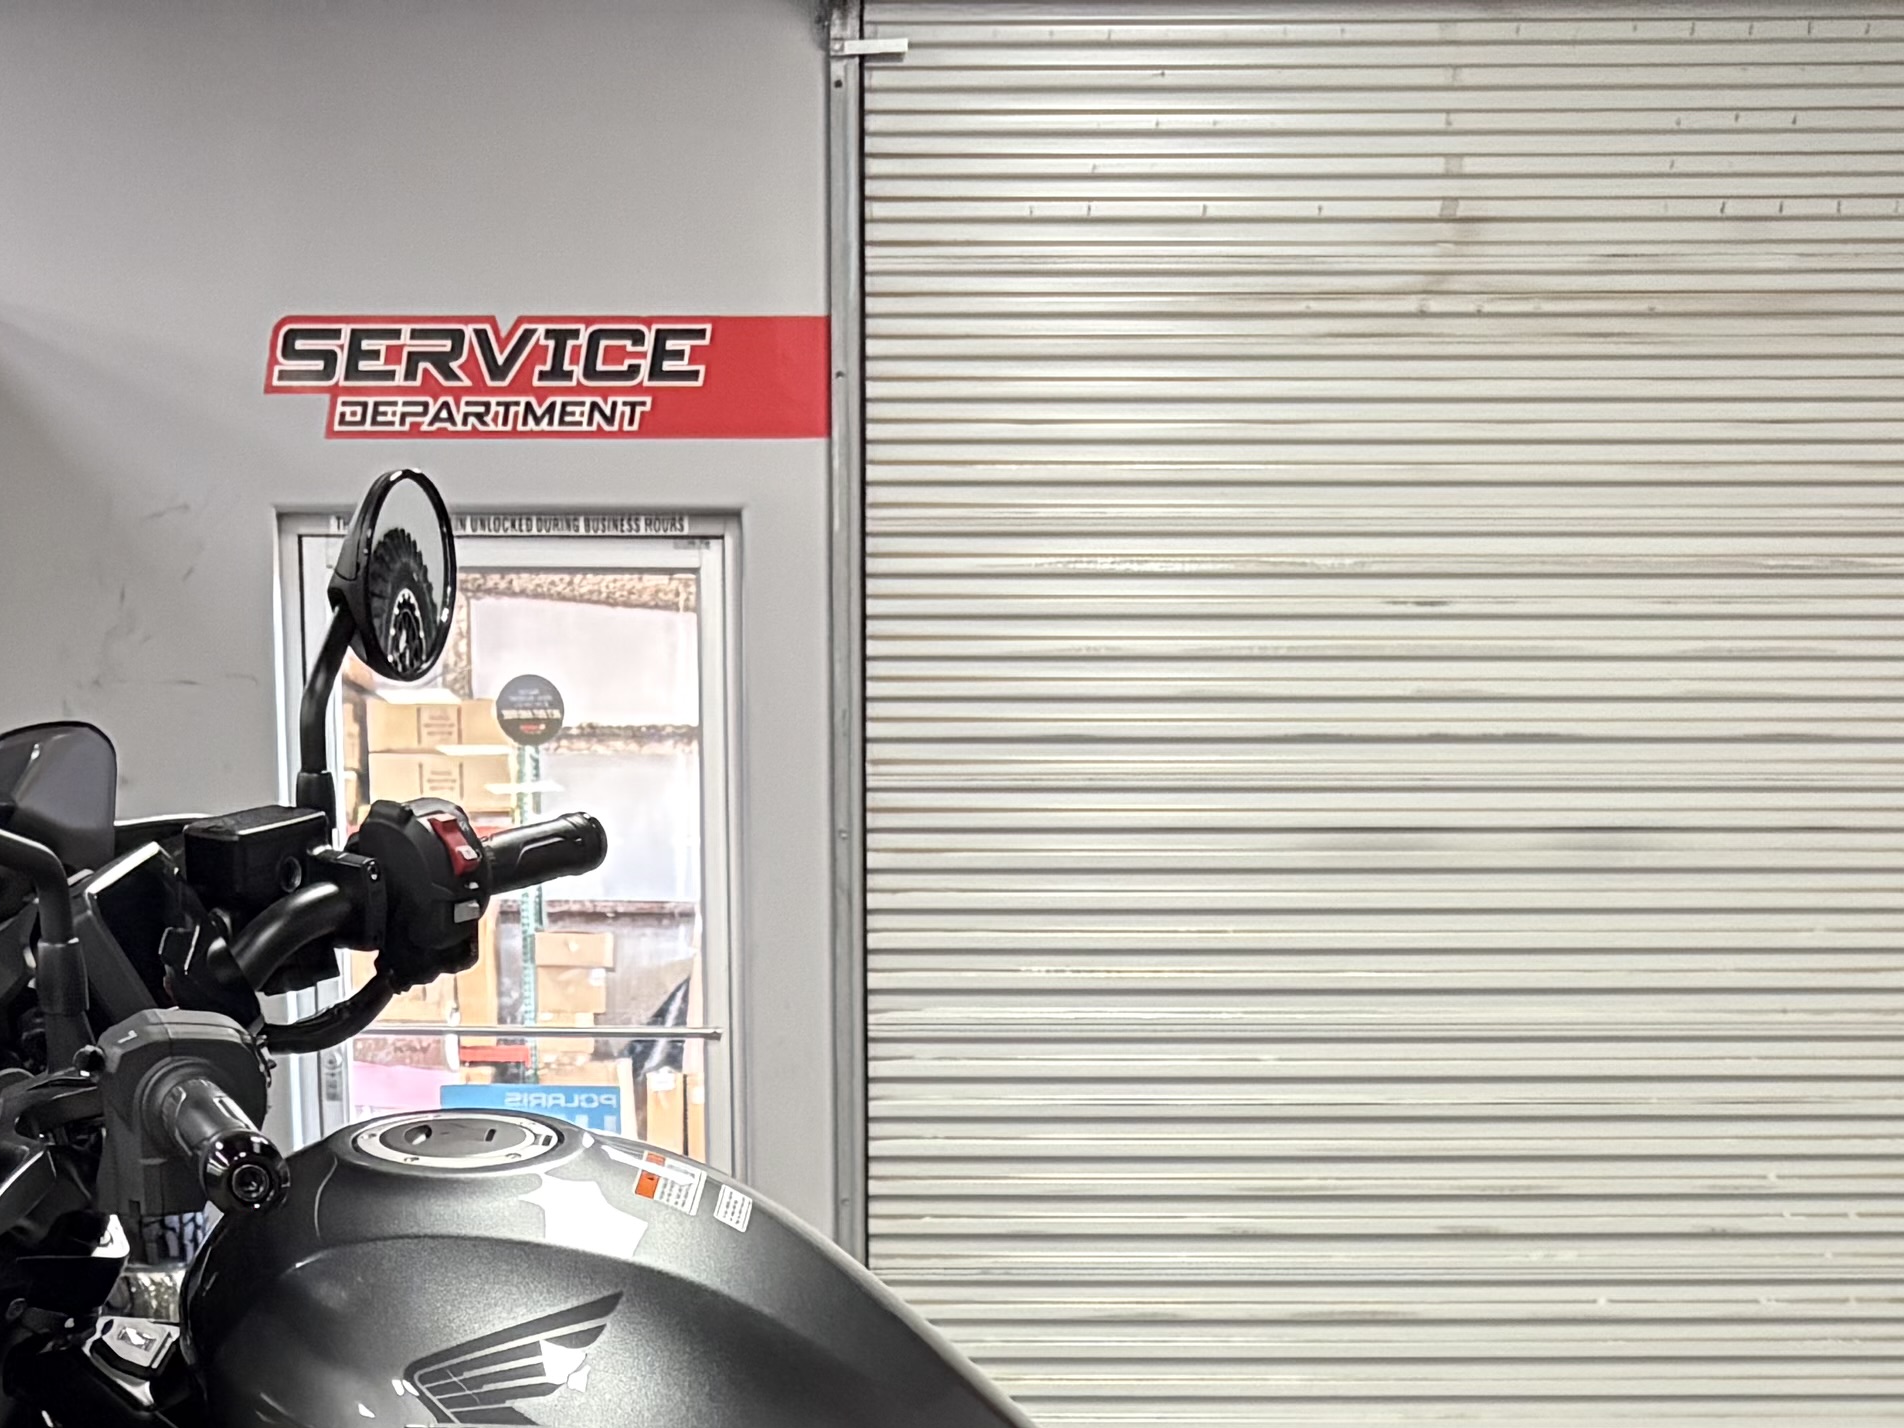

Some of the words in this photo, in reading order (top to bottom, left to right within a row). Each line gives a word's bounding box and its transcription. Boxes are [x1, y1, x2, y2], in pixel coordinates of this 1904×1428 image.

[273, 326, 711, 387] SERVICE
[336, 396, 652, 432] DEPARTMENT
[470, 515, 533, 533] UNLOCKED
[536, 515, 580, 533] DURING
[584, 515, 641, 533] BUSINESS
